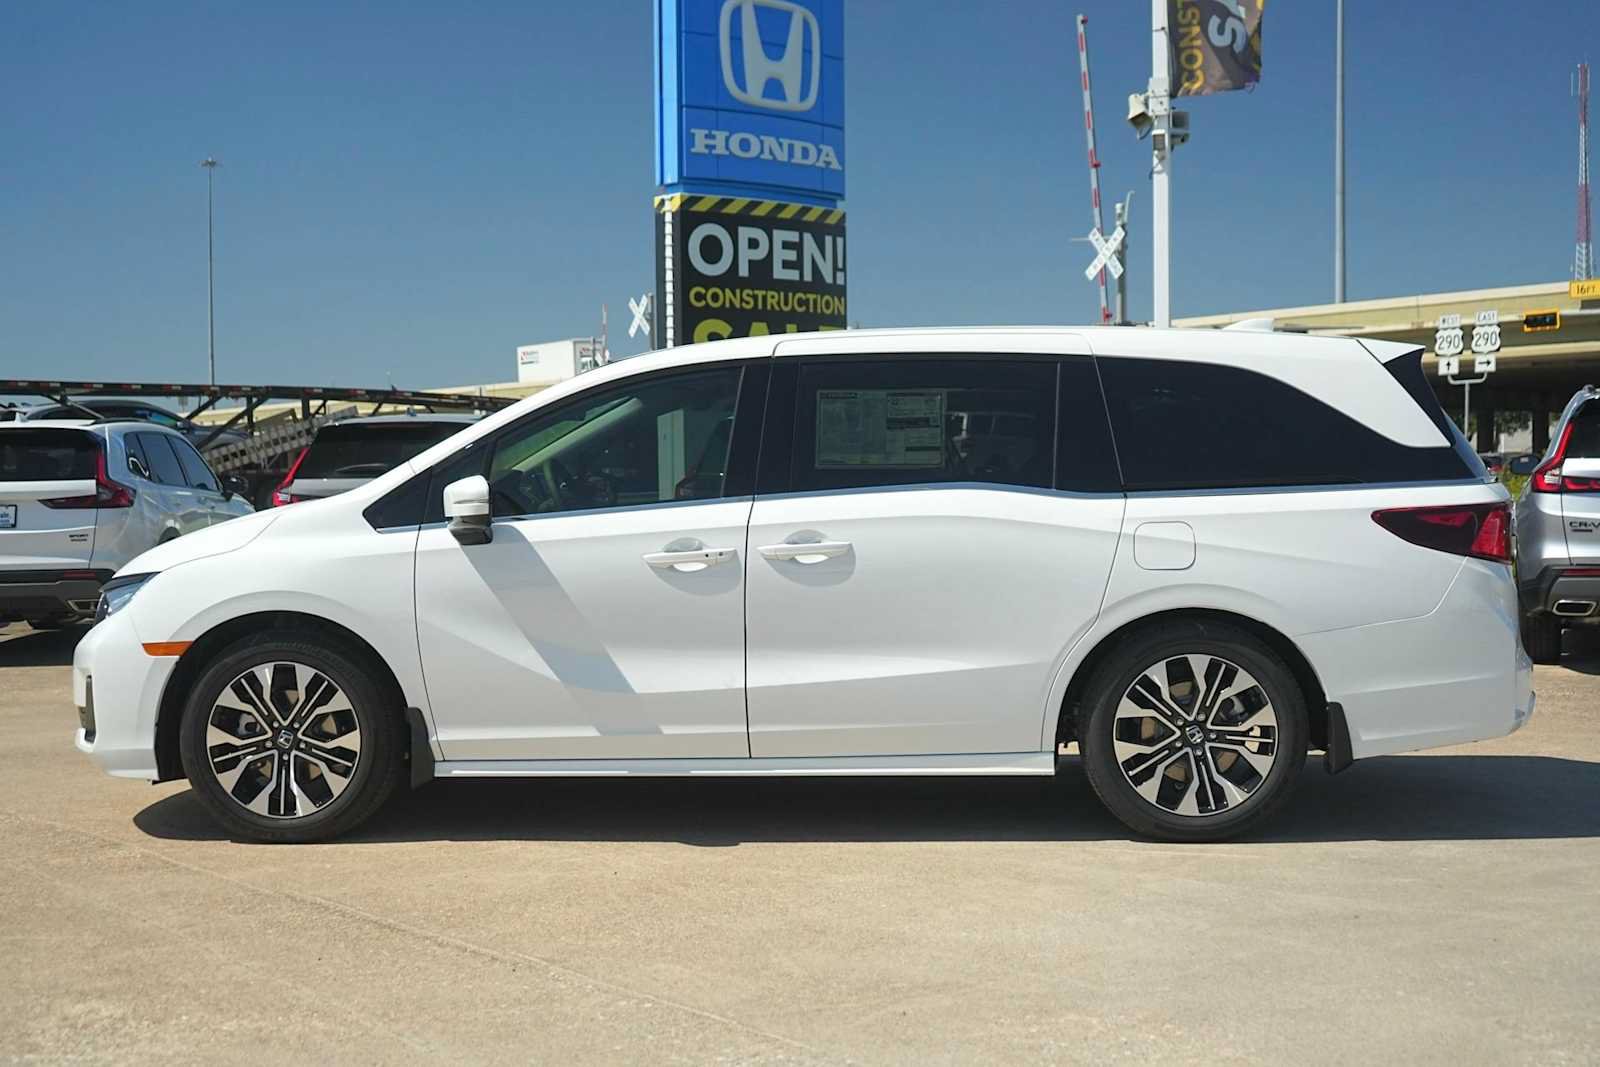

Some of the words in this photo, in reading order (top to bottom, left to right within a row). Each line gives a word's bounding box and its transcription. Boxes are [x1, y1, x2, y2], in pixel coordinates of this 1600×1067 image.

[690, 128, 843, 170] HONDA
[688, 222, 845, 286] OPEN!
[688, 286, 845, 316] CONSTRUCTION
[1438, 334, 1460, 350] 290
[1475, 331, 1498, 347] 290
